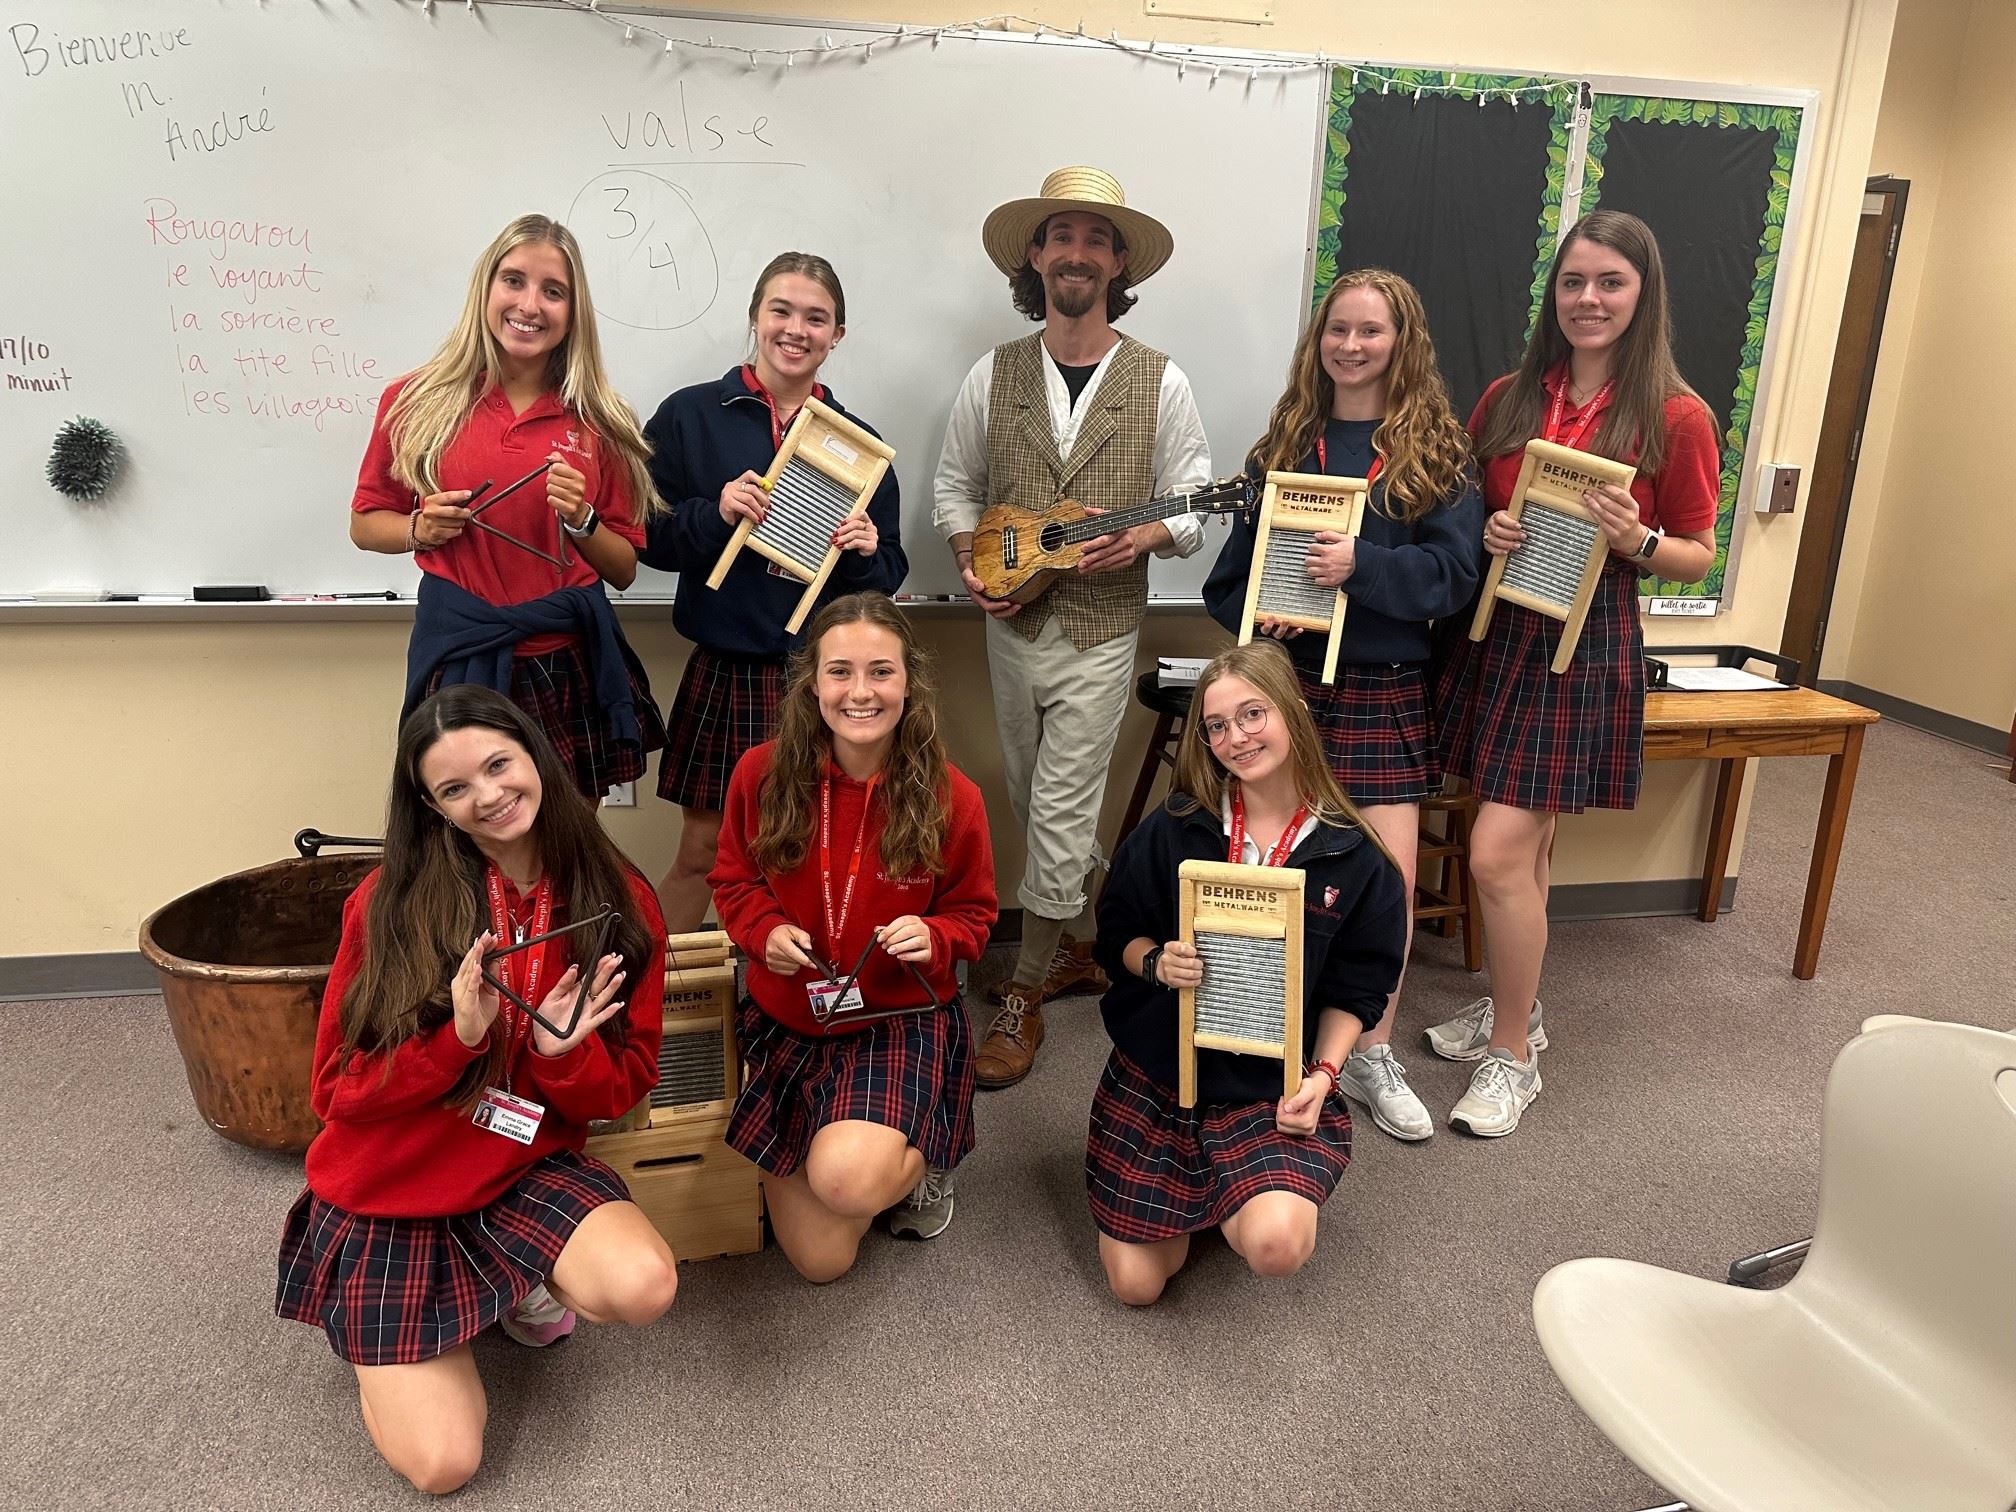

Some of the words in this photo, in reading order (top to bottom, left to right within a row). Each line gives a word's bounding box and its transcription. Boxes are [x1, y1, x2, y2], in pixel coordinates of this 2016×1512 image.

[8, 23, 192, 77] Bienvenue
[164, 86, 276, 162] André
[601, 80, 774, 154] valse
[143, 197, 312, 261] Rougarou
[167, 257, 190, 287] le
[169, 304, 201, 333] la
[220, 306, 340, 337] sorcière
[176, 343, 208, 374] la
[311, 344, 384, 379] fille
[6, 367, 73, 393] minuit
[182, 382, 231, 416] les
[1543, 462, 1607, 490] BEHRENS
[1550, 478, 1582, 493] METALWA
[1282, 491, 1345, 506] BEHRENS
[1290, 505, 1333, 513] METALWARE
[1281, 825, 1298, 852] Academy
[490, 876, 501, 906] Joseph's
[843, 875, 856, 903] Academy
[1202, 886, 1278, 904] BEHRENS
[536, 899, 547, 930] Joseph's
[1214, 901, 1265, 913] METALWARE
[663, 990, 713, 1004] HRENS
